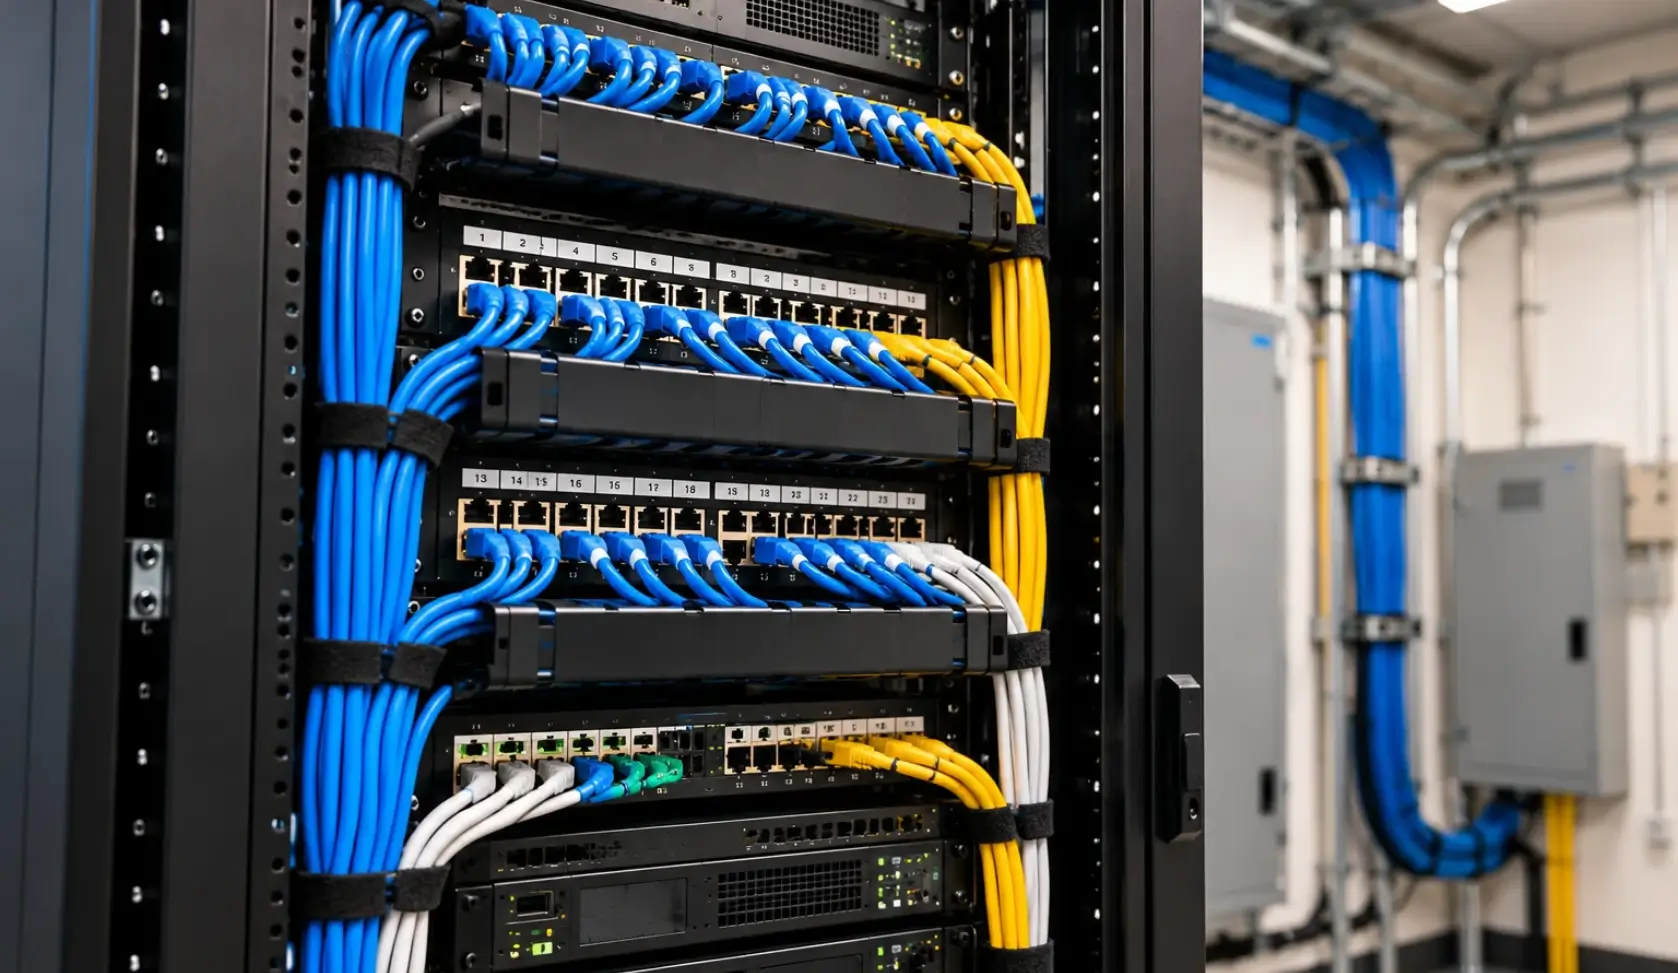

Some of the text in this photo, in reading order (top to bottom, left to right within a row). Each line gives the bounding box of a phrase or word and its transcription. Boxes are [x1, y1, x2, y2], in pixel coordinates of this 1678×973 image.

[479, 233, 485, 242] 1
[519, 239, 527, 248] 2
[572, 246, 579, 255] 4
[611, 252, 619, 261] 5
[650, 258, 657, 267] 6
[475, 474, 488, 483] 13
[511, 476, 523, 485] 14
[570, 479, 582, 488] 16
[685, 484, 696, 494] 18
